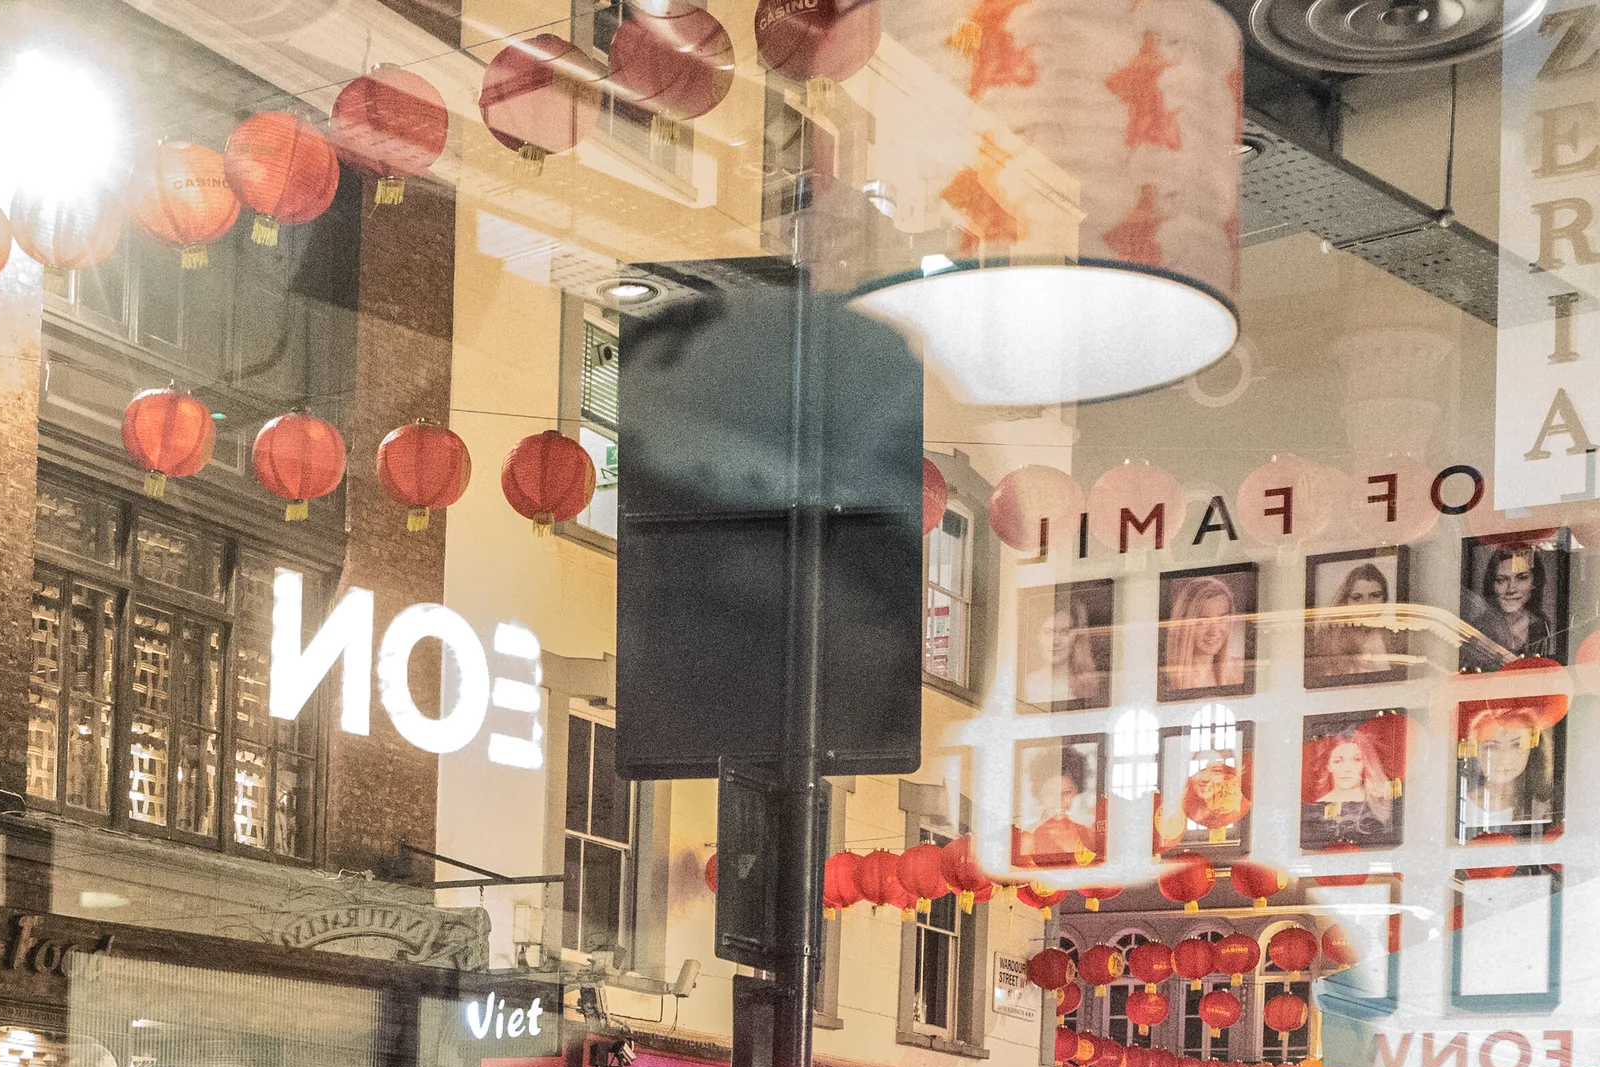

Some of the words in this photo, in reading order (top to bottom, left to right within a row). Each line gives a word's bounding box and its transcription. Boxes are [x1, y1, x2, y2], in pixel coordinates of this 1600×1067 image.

[1221, 946, 1249, 955] CASINO
[998, 972, 1019, 988] STREET
[466, 991, 544, 1040] Viet
